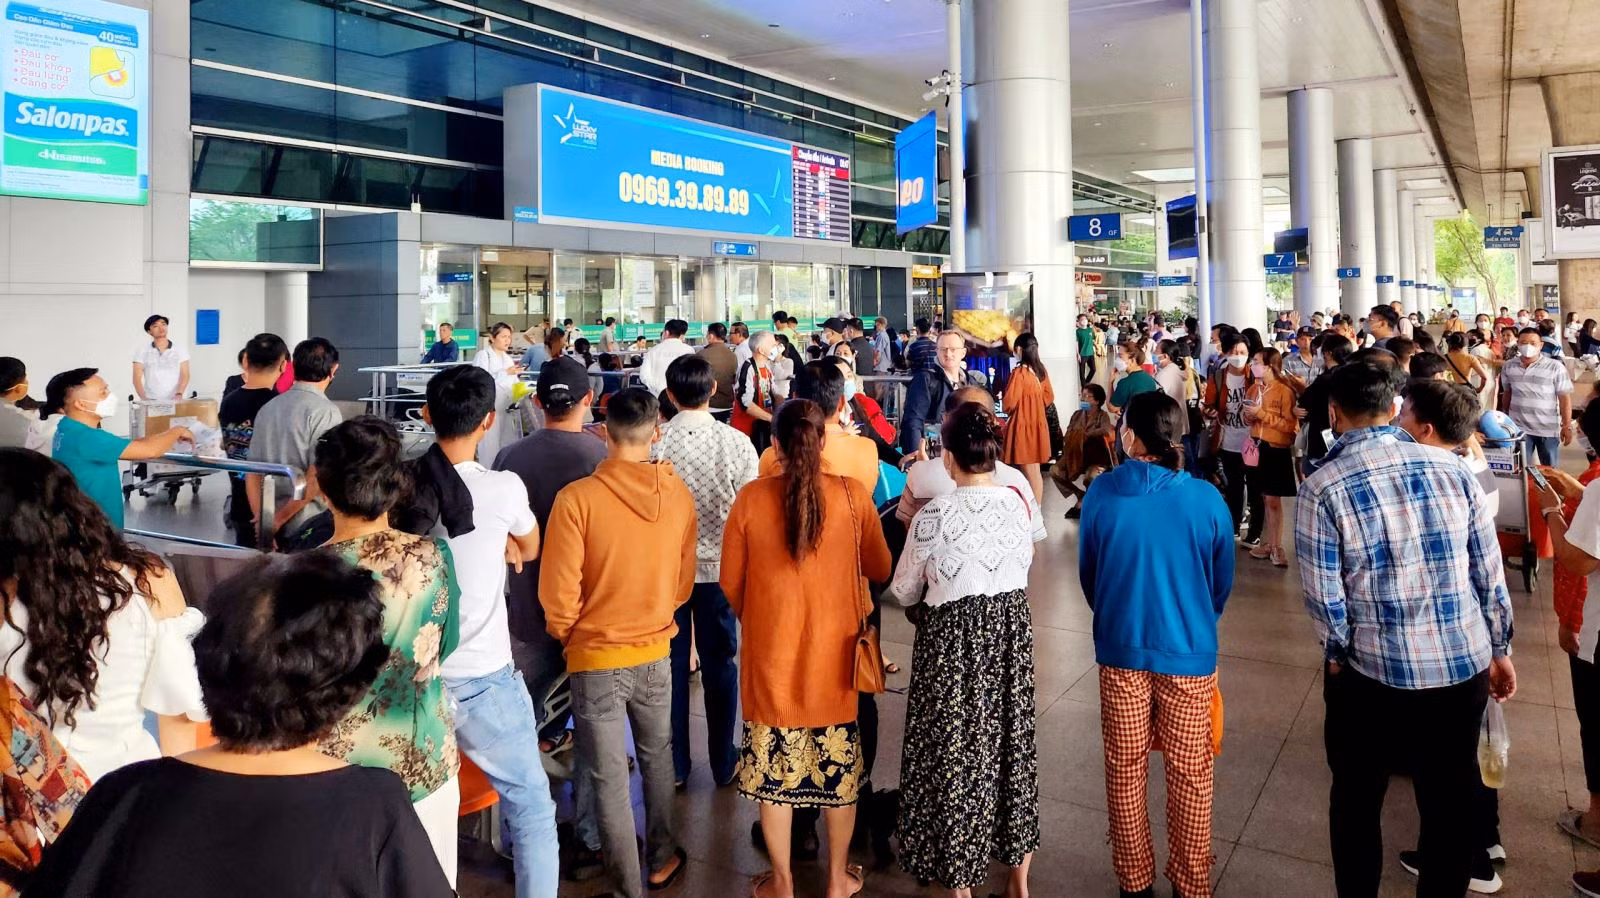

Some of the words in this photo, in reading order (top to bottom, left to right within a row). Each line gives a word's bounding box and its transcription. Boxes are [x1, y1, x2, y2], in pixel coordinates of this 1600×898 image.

[98, 31, 114, 43] 40
[16, 101, 127, 137] Salonpas
[572, 129, 597, 141] STAR
[650, 149, 683, 170] MEDIA
[684, 155, 724, 176] BOOKING
[618, 171, 749, 216] 0969.39.89.89
[1089, 218, 1102, 236] 8
[1275, 255, 1285, 266] 7
[1346, 269, 1353, 277] 6
